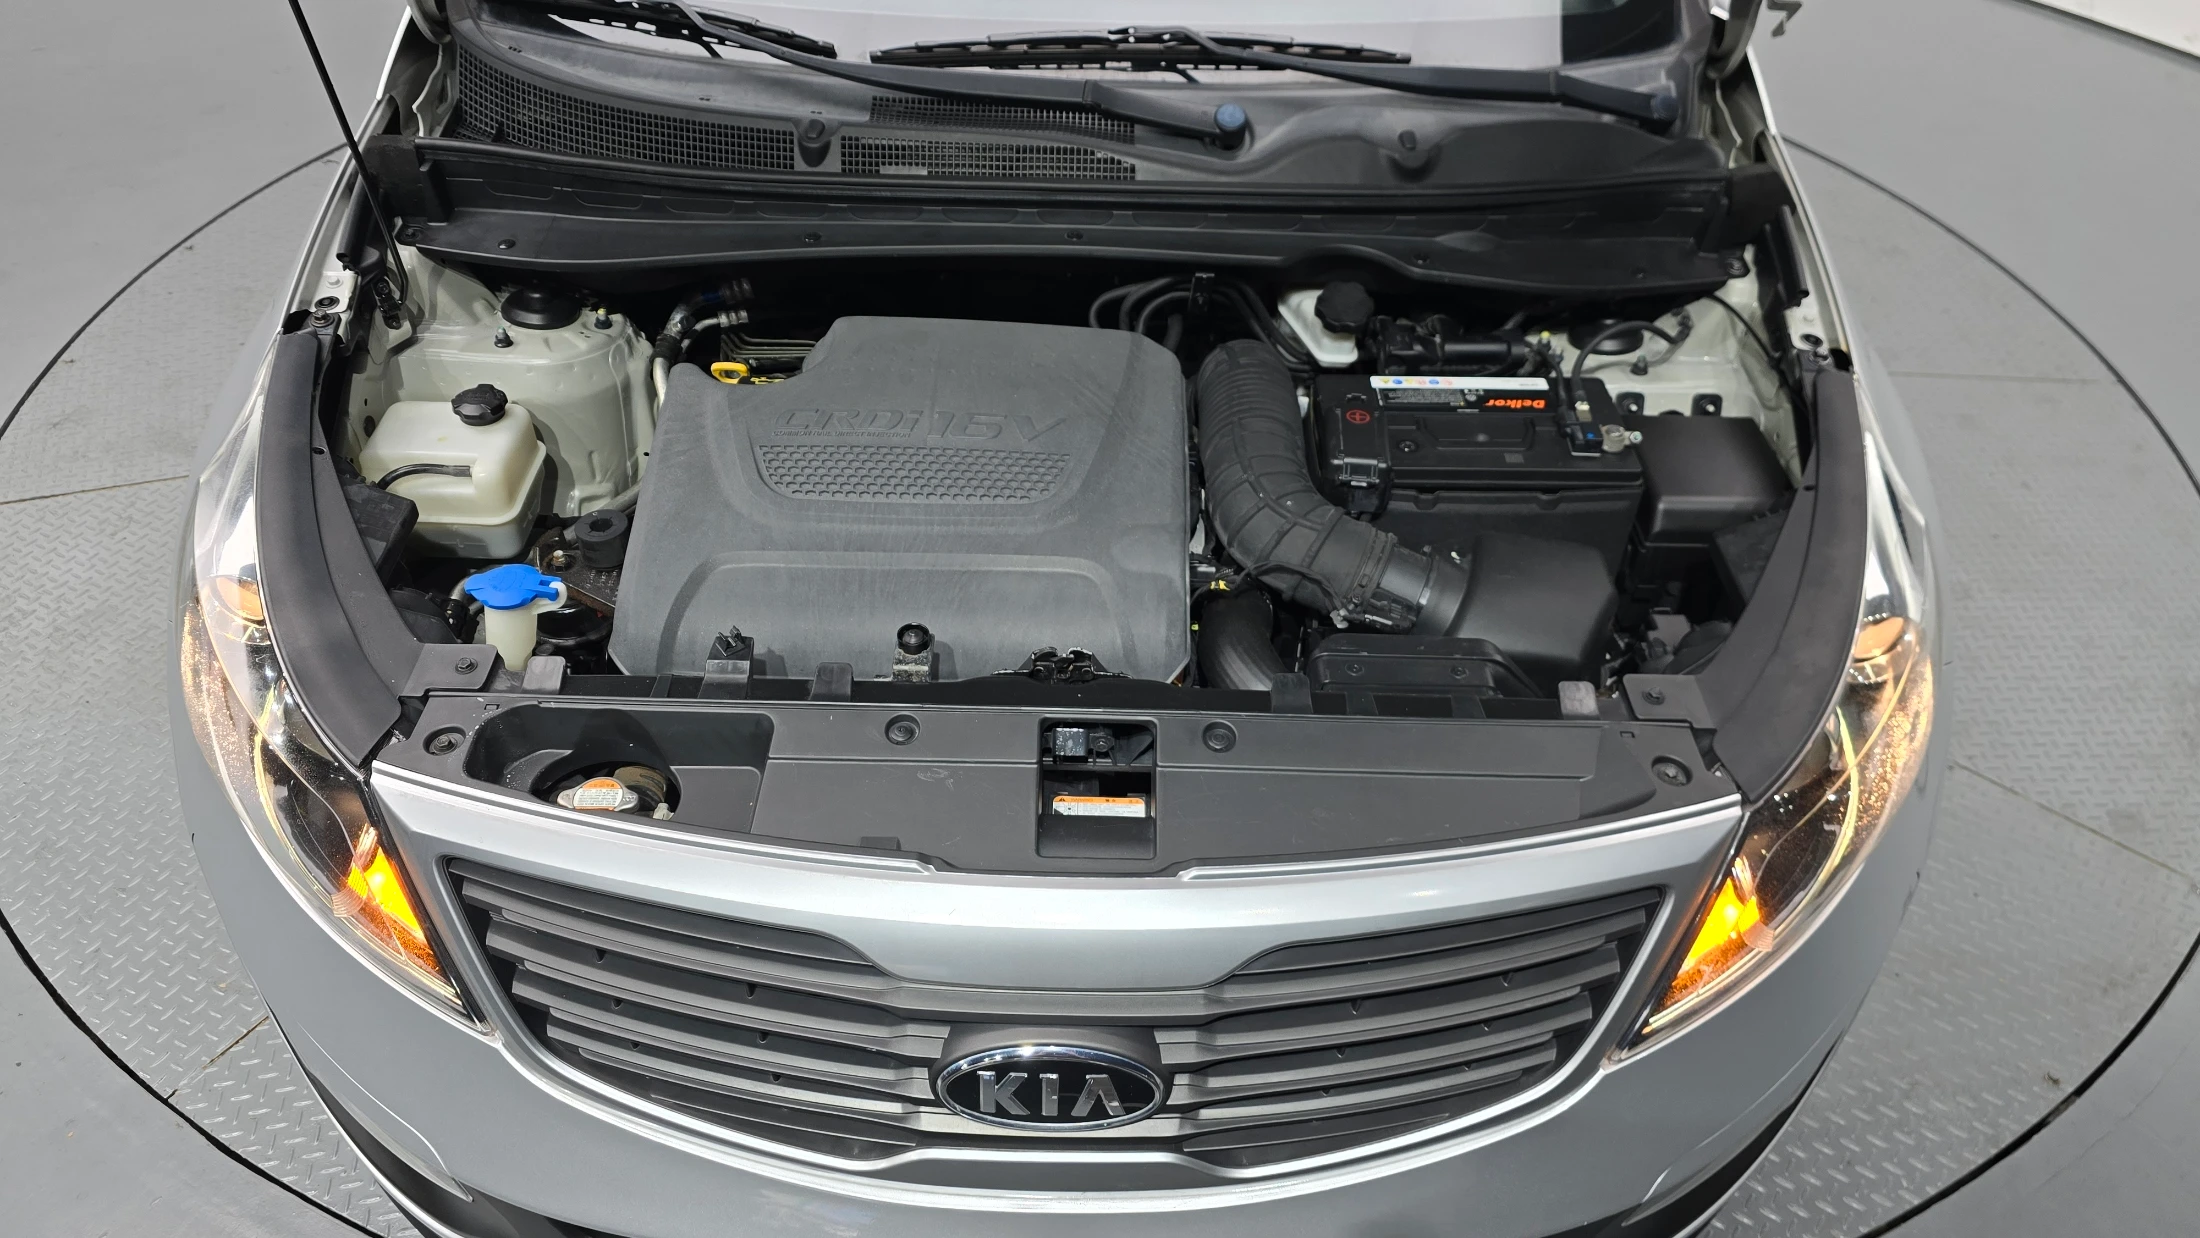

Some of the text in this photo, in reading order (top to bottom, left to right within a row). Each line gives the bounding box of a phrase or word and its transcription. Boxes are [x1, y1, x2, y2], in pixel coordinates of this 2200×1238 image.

[1485, 399, 1546, 409] Delkor
[775, 408, 1068, 442] CRDi 16V
[976, 1070, 1127, 1117] KIA
